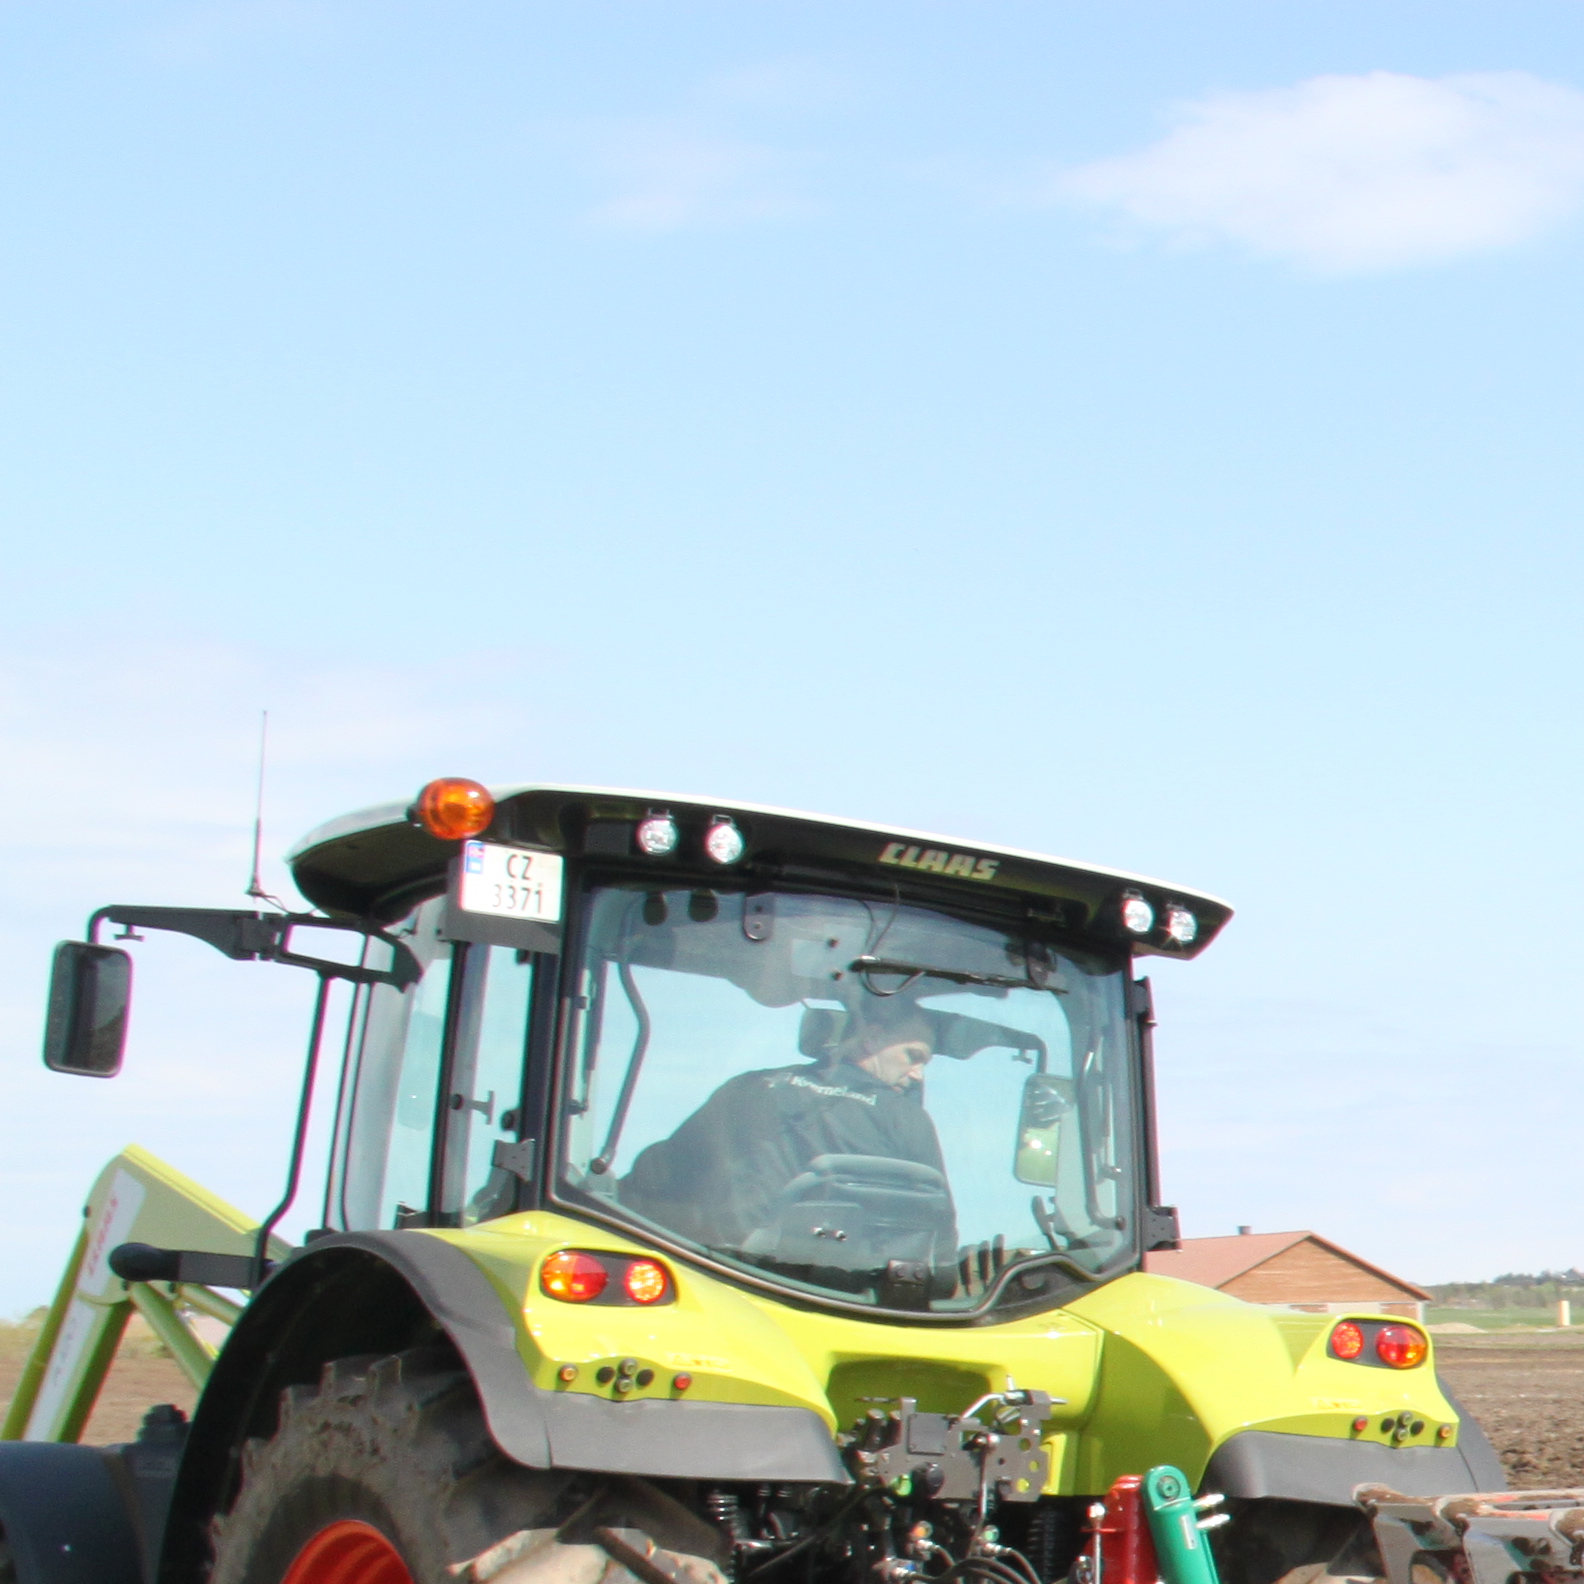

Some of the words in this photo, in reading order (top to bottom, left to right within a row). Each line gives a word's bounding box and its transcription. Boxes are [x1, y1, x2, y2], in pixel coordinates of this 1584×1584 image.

[506, 853, 533, 881] CZ
[879, 842, 1000, 881] CLAAS
[492, 883, 543, 914] 3371
